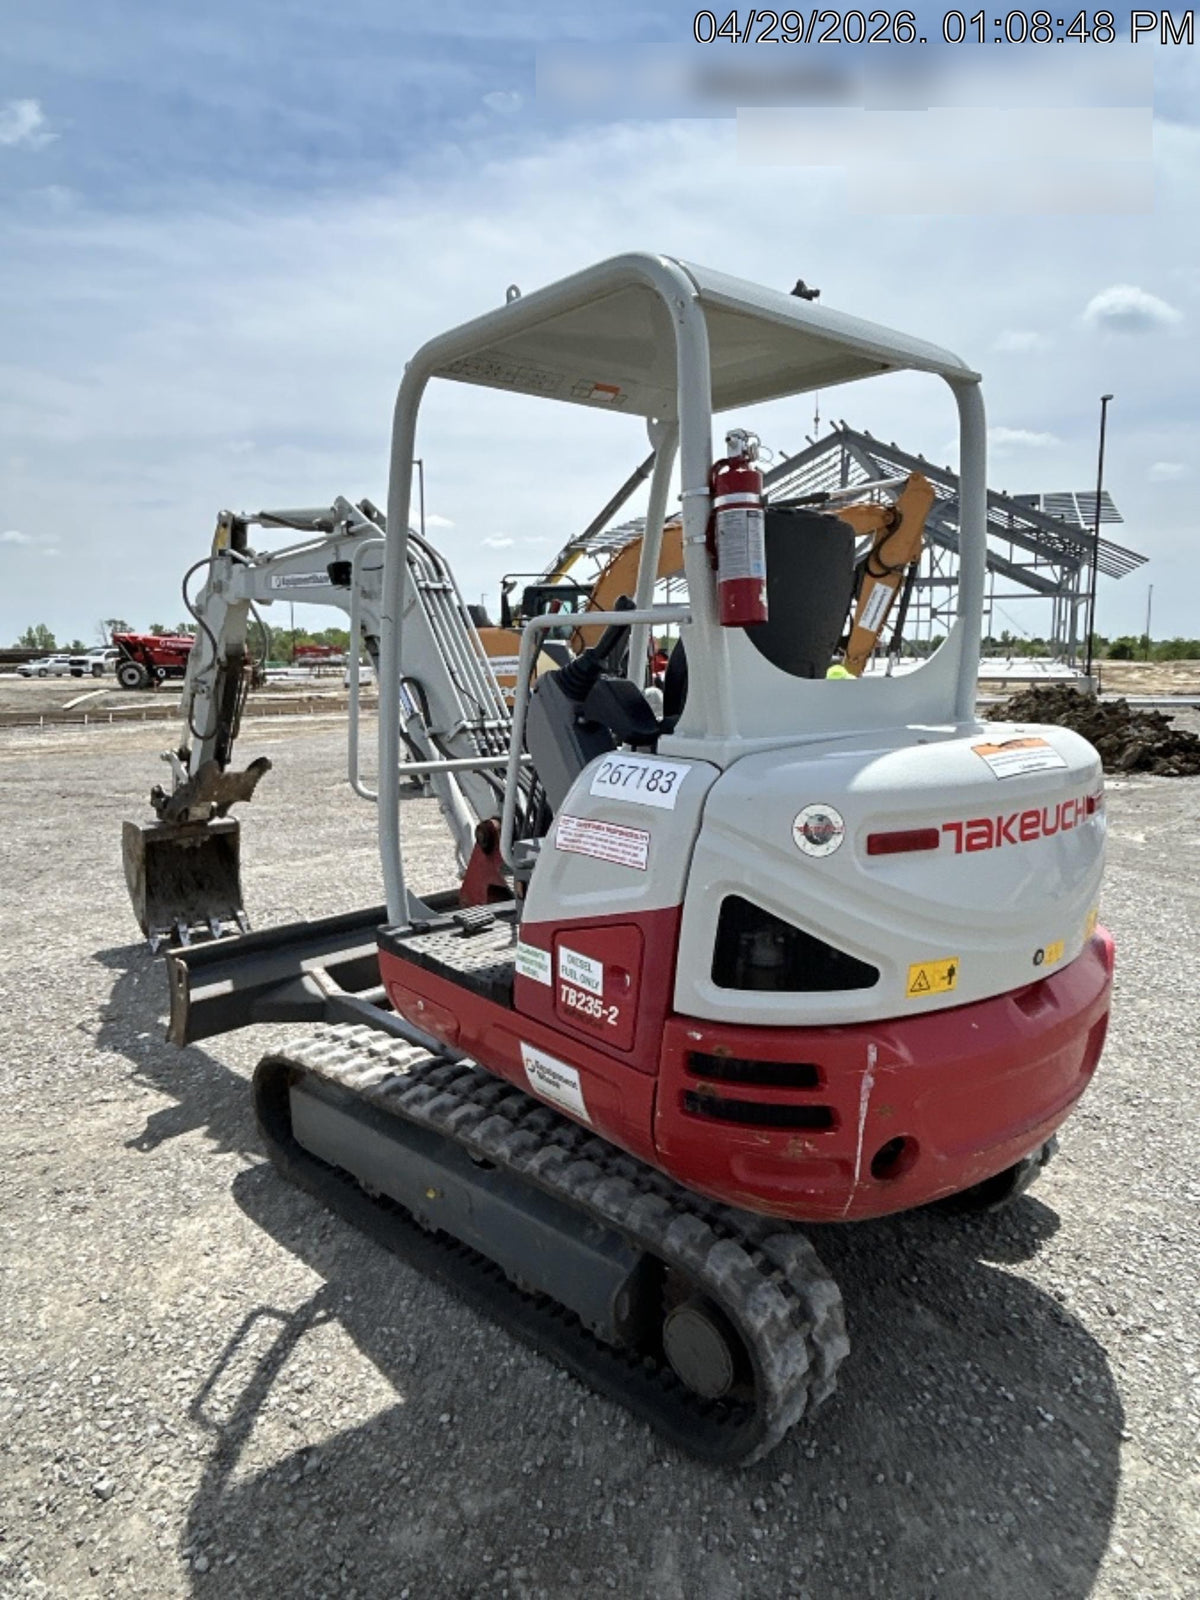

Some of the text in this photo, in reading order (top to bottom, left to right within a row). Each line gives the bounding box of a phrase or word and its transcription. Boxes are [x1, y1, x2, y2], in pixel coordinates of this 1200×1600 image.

[597, 762, 677, 793] 267183
[561, 965, 600, 990] FUEL ONLY
[561, 984, 619, 1026] TB235-2
